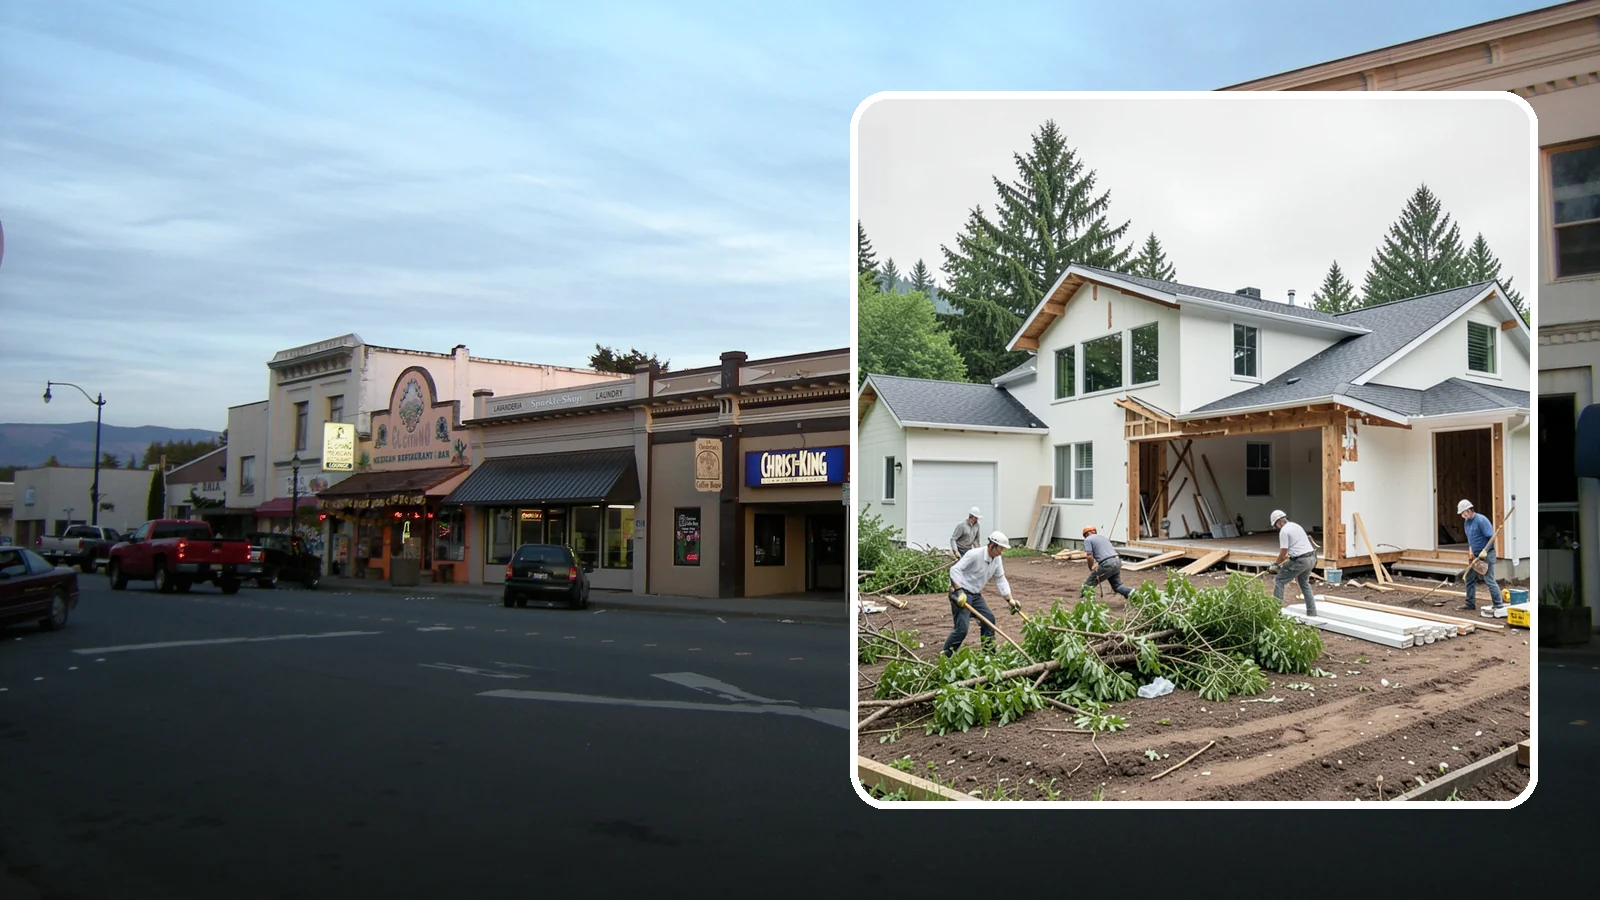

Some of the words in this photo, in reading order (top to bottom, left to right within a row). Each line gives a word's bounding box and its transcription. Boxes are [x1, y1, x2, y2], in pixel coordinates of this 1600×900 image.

[493, 402, 523, 413] LAVANDERIA
[562, 394, 583, 406] Shop
[595, 388, 624, 400] LAUNDRY
[373, 454, 397, 465] MEXICAN
[397, 450, 434, 463] RESTAURANT
[437, 449, 450, 459] BAR
[760, 452, 797, 478] CHRIST
[799, 450, 827, 477] KING
